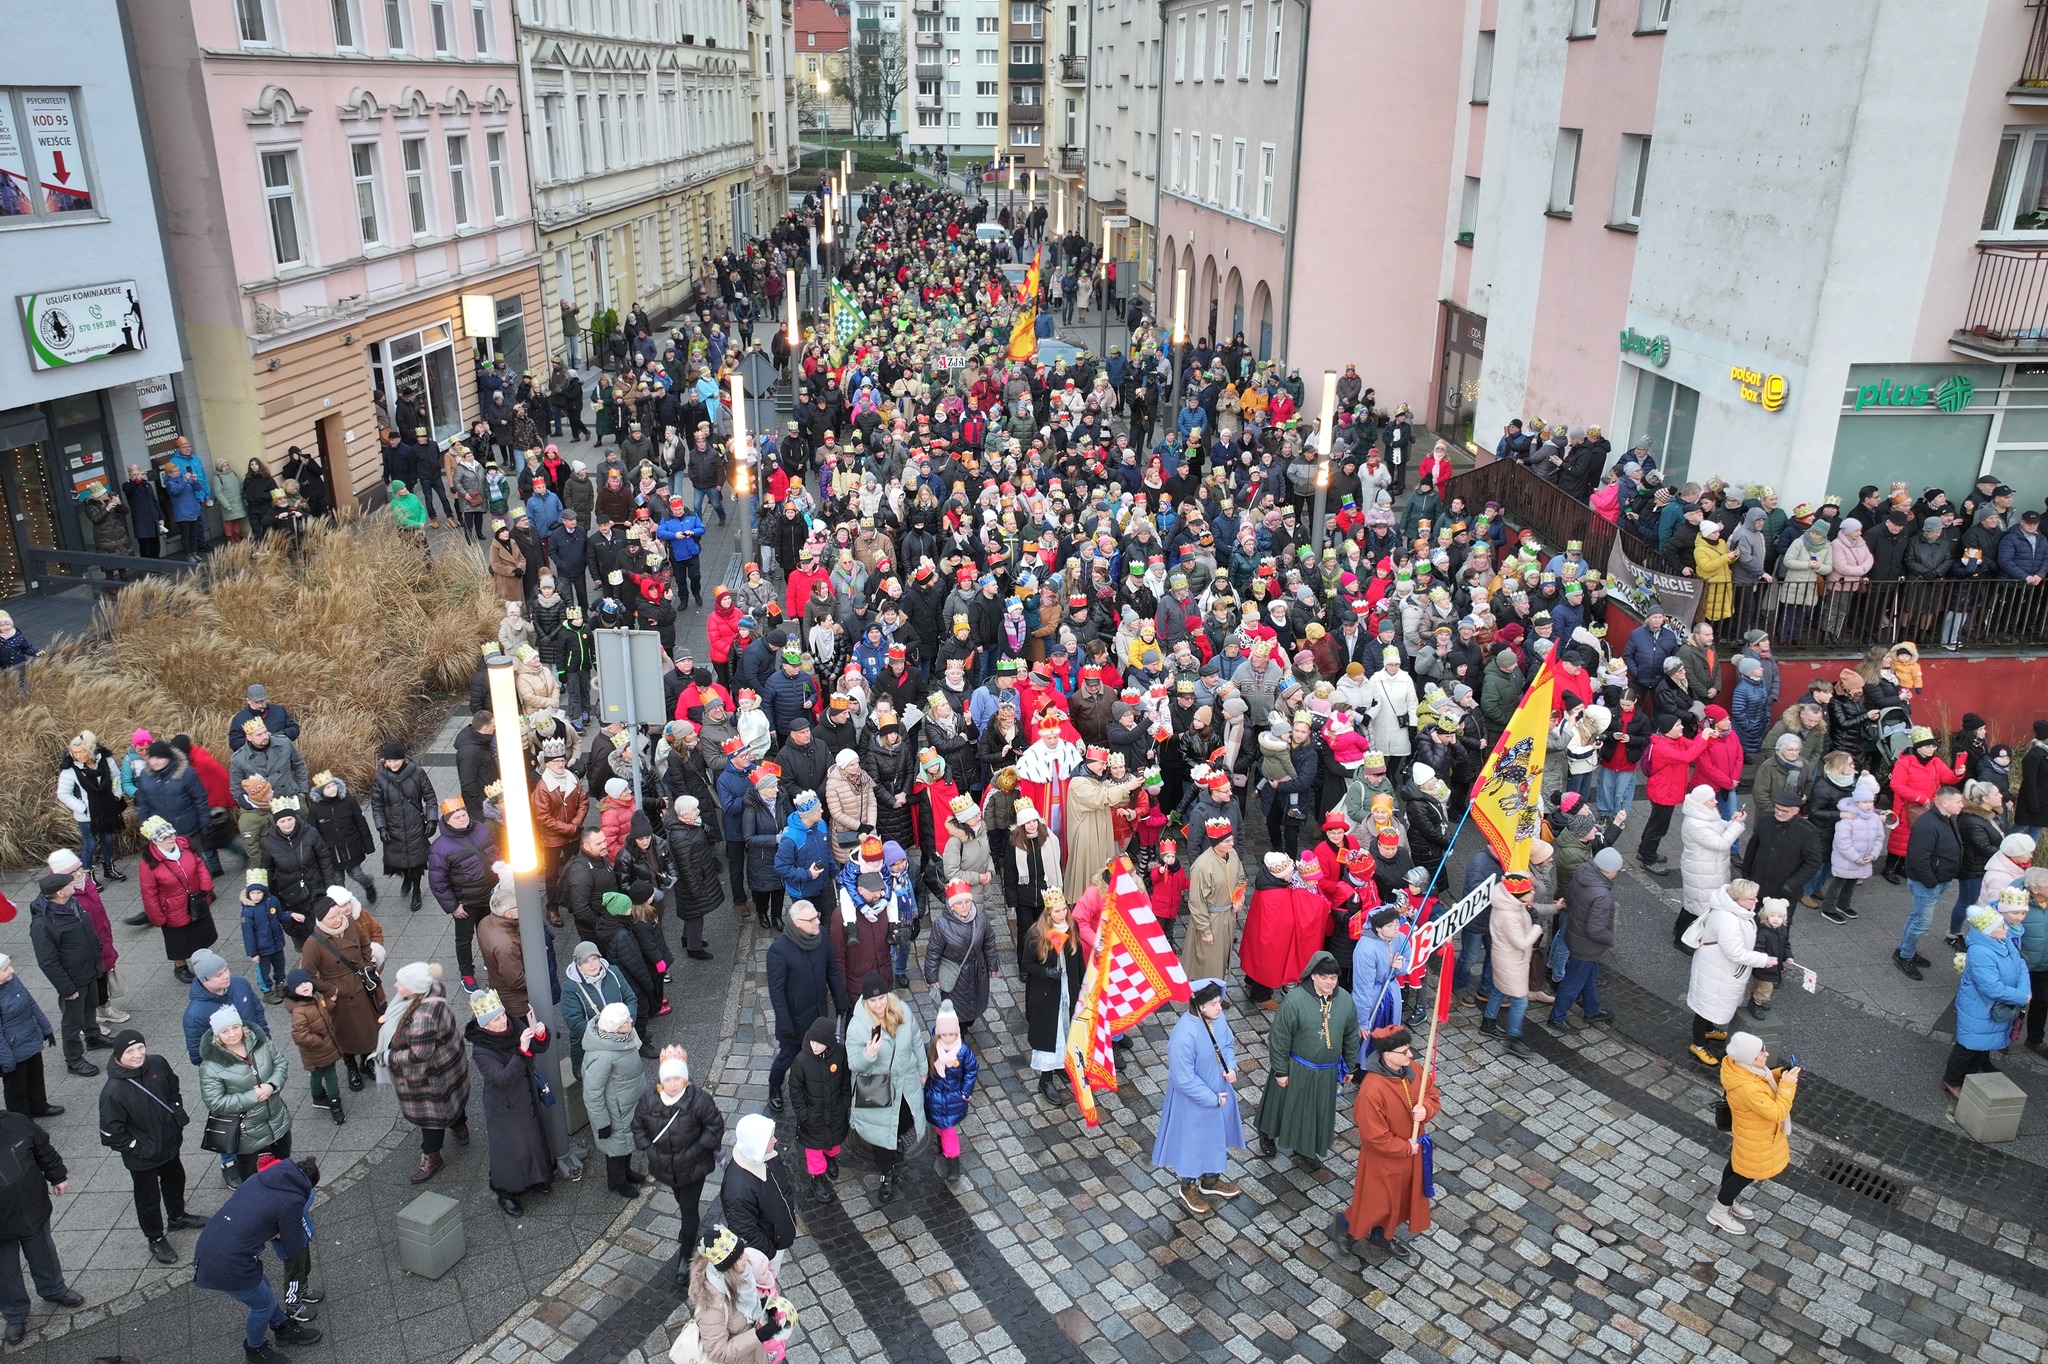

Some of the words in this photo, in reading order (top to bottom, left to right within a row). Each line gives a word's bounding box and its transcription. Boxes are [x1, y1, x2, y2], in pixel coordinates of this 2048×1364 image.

[26, 97, 67, 105] PSYCHOTESTY
[32, 115, 54, 126] KOD
[56, 115, 69, 126] 95
[38, 136, 72, 147] WEJŚCIE
[45, 295, 72, 306] USŁUGI
[73, 286, 122, 300] KOMINIARSKIE
[79, 324, 92, 333] 570
[92, 322, 105, 331] 195
[105, 319, 117, 329] 286
[1620, 327, 1652, 356] plus
[1730, 365, 1763, 387] polsat
[1740, 384, 1759, 403] box
[1853, 378, 1931, 412] plus
[1630, 564, 1694, 593] OTARCIE
[1411, 884, 1490, 967] EUROPA
